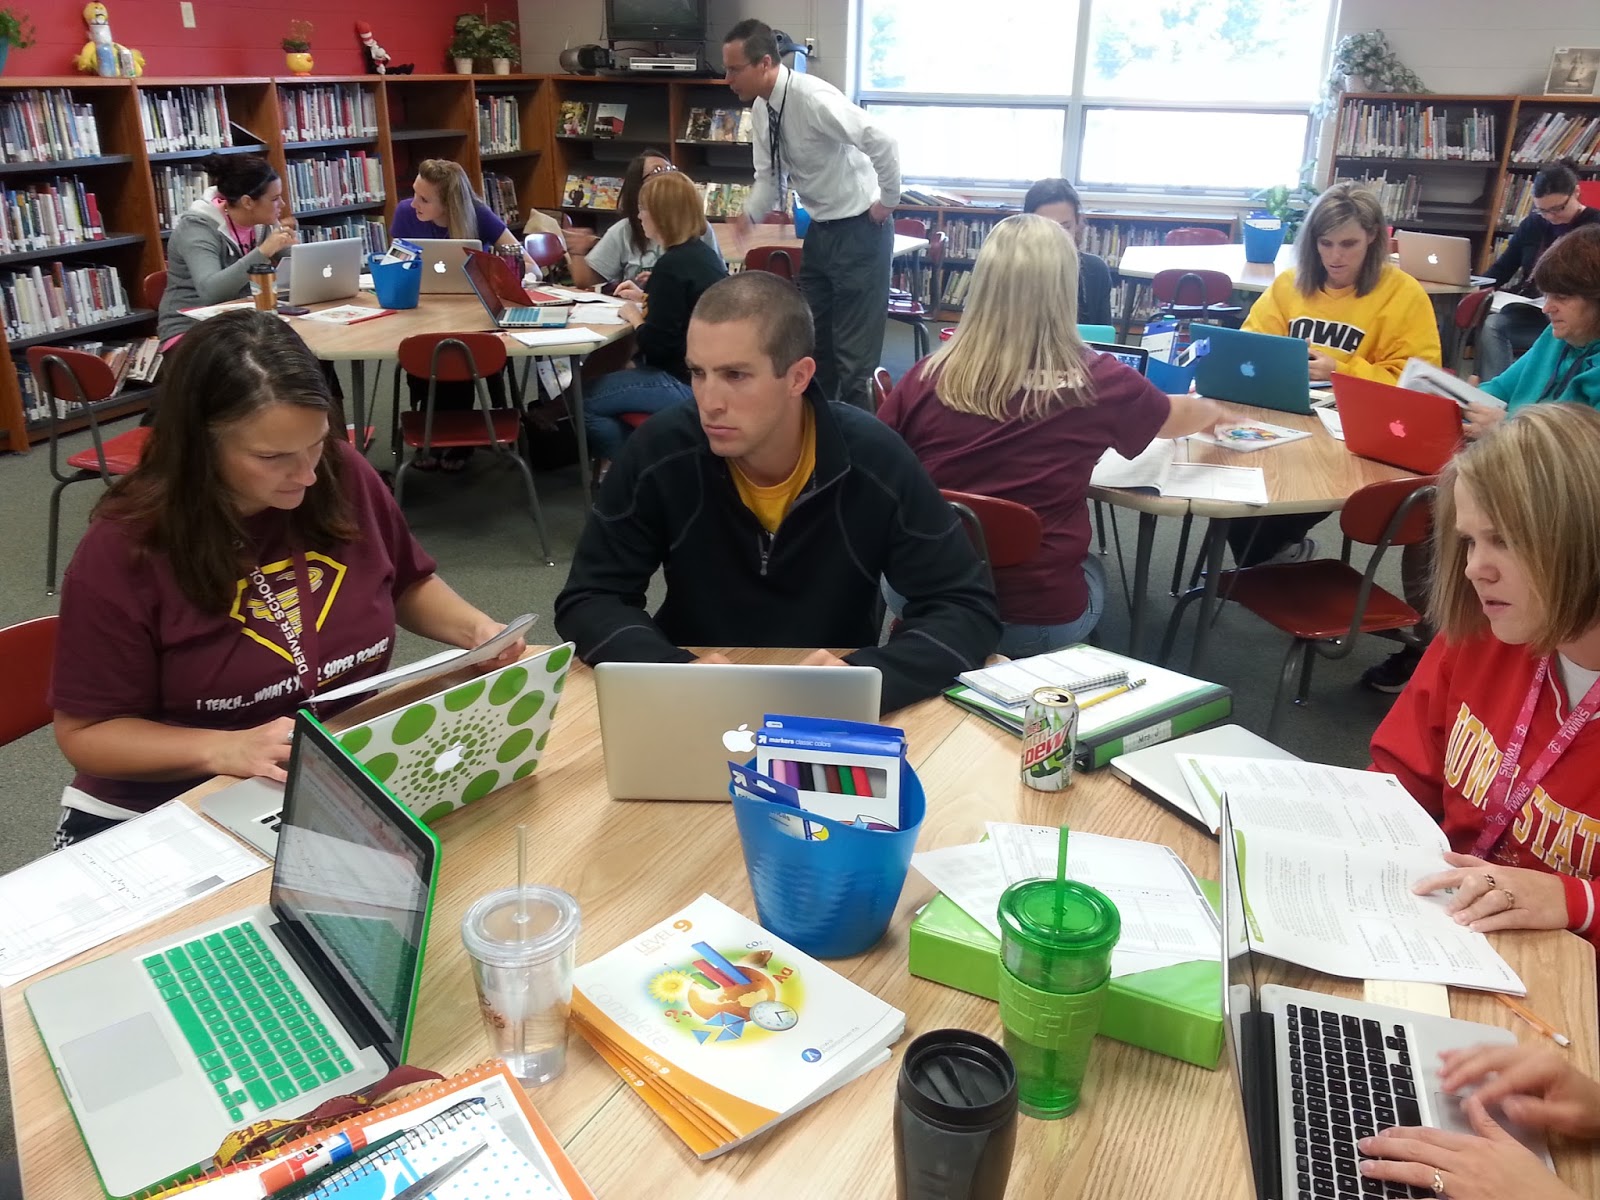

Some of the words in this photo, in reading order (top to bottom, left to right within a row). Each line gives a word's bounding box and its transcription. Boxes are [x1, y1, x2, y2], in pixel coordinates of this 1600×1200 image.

[249, 565, 285, 621] SCHOOL
[280, 620, 309, 675] DENVER
[323, 662, 355, 679] SUPER
[769, 737, 794, 745] markers
[1562, 709, 1591, 741] TWINS
[1443, 702, 1521, 811] IOW
[1499, 742, 1520, 778] TWINS
[1507, 784, 1531, 815] TWINS
[635, 928, 675, 956] LEVEL
[673, 919, 693, 932] 9
[772, 966, 794, 985] Aa
[634, 1079, 645, 1087] 9
